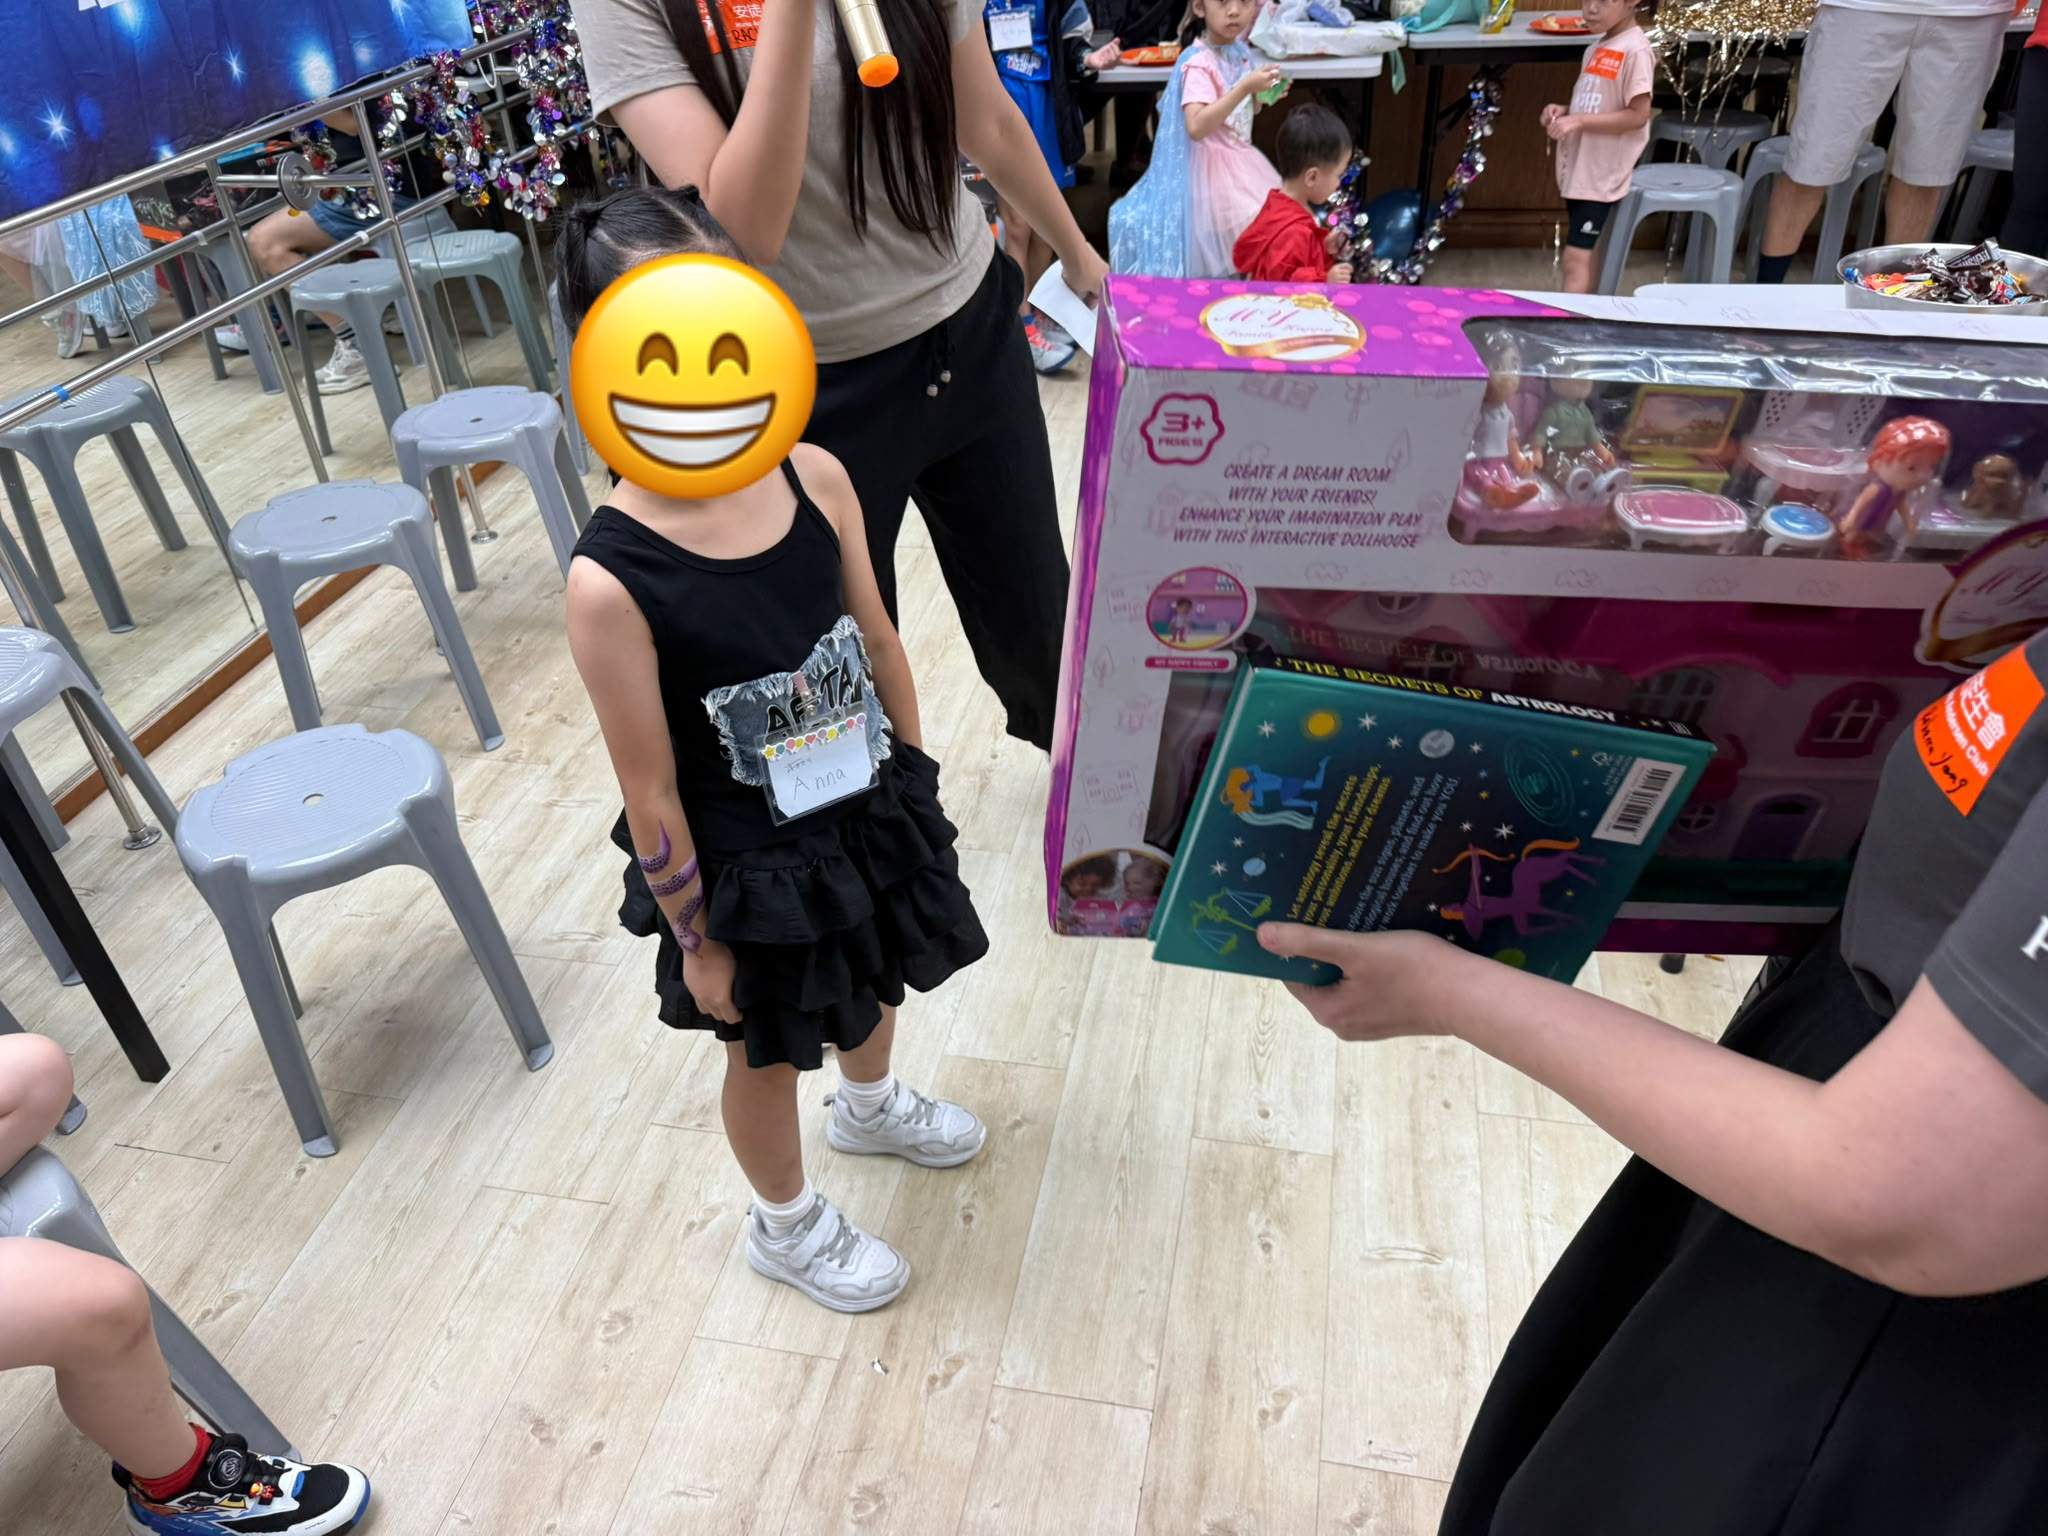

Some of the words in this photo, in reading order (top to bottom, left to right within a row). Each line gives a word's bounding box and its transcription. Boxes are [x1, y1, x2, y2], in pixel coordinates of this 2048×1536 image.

[732, 27, 758, 43] RAC
[1162, 412, 1205, 432] 3+
[1224, 463, 1276, 479] CREATE
[1277, 465, 1289, 479] A
[1292, 465, 1343, 481] DREAM
[1346, 466, 1391, 482] ROOM
[1228, 486, 1268, 501] WITH
[1270, 487, 1308, 503] YOUR
[1179, 506, 1245, 523] ENHANCE
[1247, 508, 1286, 524] YOUR
[1288, 509, 1386, 526] IMAGINATION
[1388, 511, 1424, 527] PLAY
[1174, 528, 1212, 542] WITH
[1215, 529, 1248, 543] THIS
[1249, 529, 1339, 546] INTERACTIVE
[1341, 532, 1420, 548] DOLLHOUSE
[1288, 658, 1339, 678] THE
[1343, 666, 1449, 696] SECRETS
[1453, 687, 1483, 700] OF
[1490, 692, 1616, 722] ASTROLOGY
[1965, 745, 1989, 777] Club
[793, 768, 848, 801] Anna
[1294, 859, 1322, 903] astrology
[1287, 903, 1302, 919] Let
